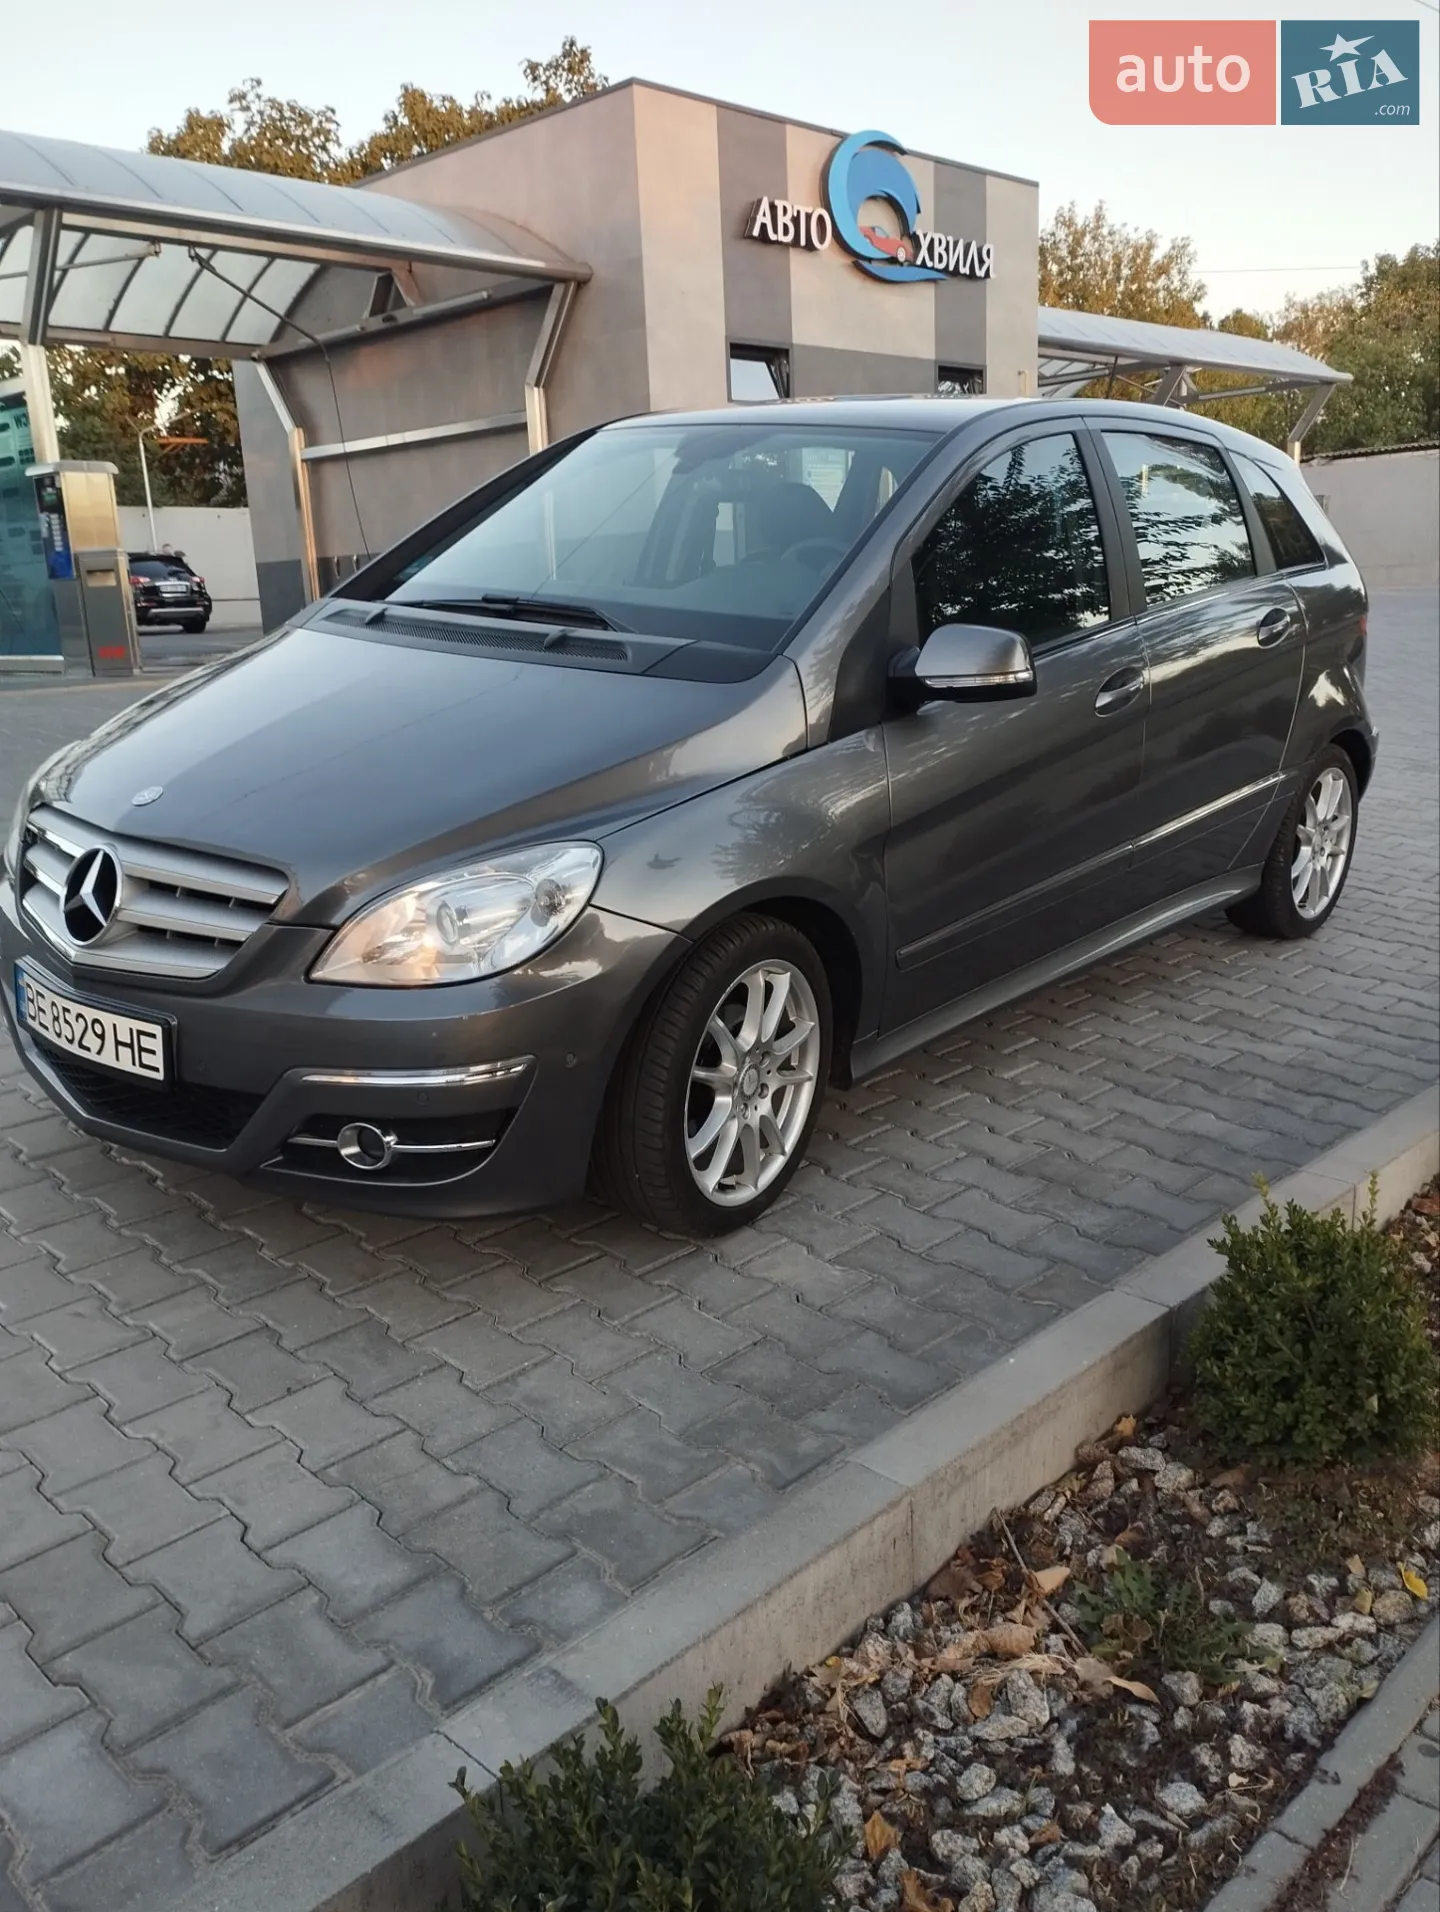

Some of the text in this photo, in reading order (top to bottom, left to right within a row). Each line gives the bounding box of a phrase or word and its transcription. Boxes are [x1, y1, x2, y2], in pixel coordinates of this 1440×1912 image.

[752, 196, 832, 250] АВТО
[915, 229, 996, 279] ХВИЛЯ
[26, 983, 160, 1073] BE 8529 HE
